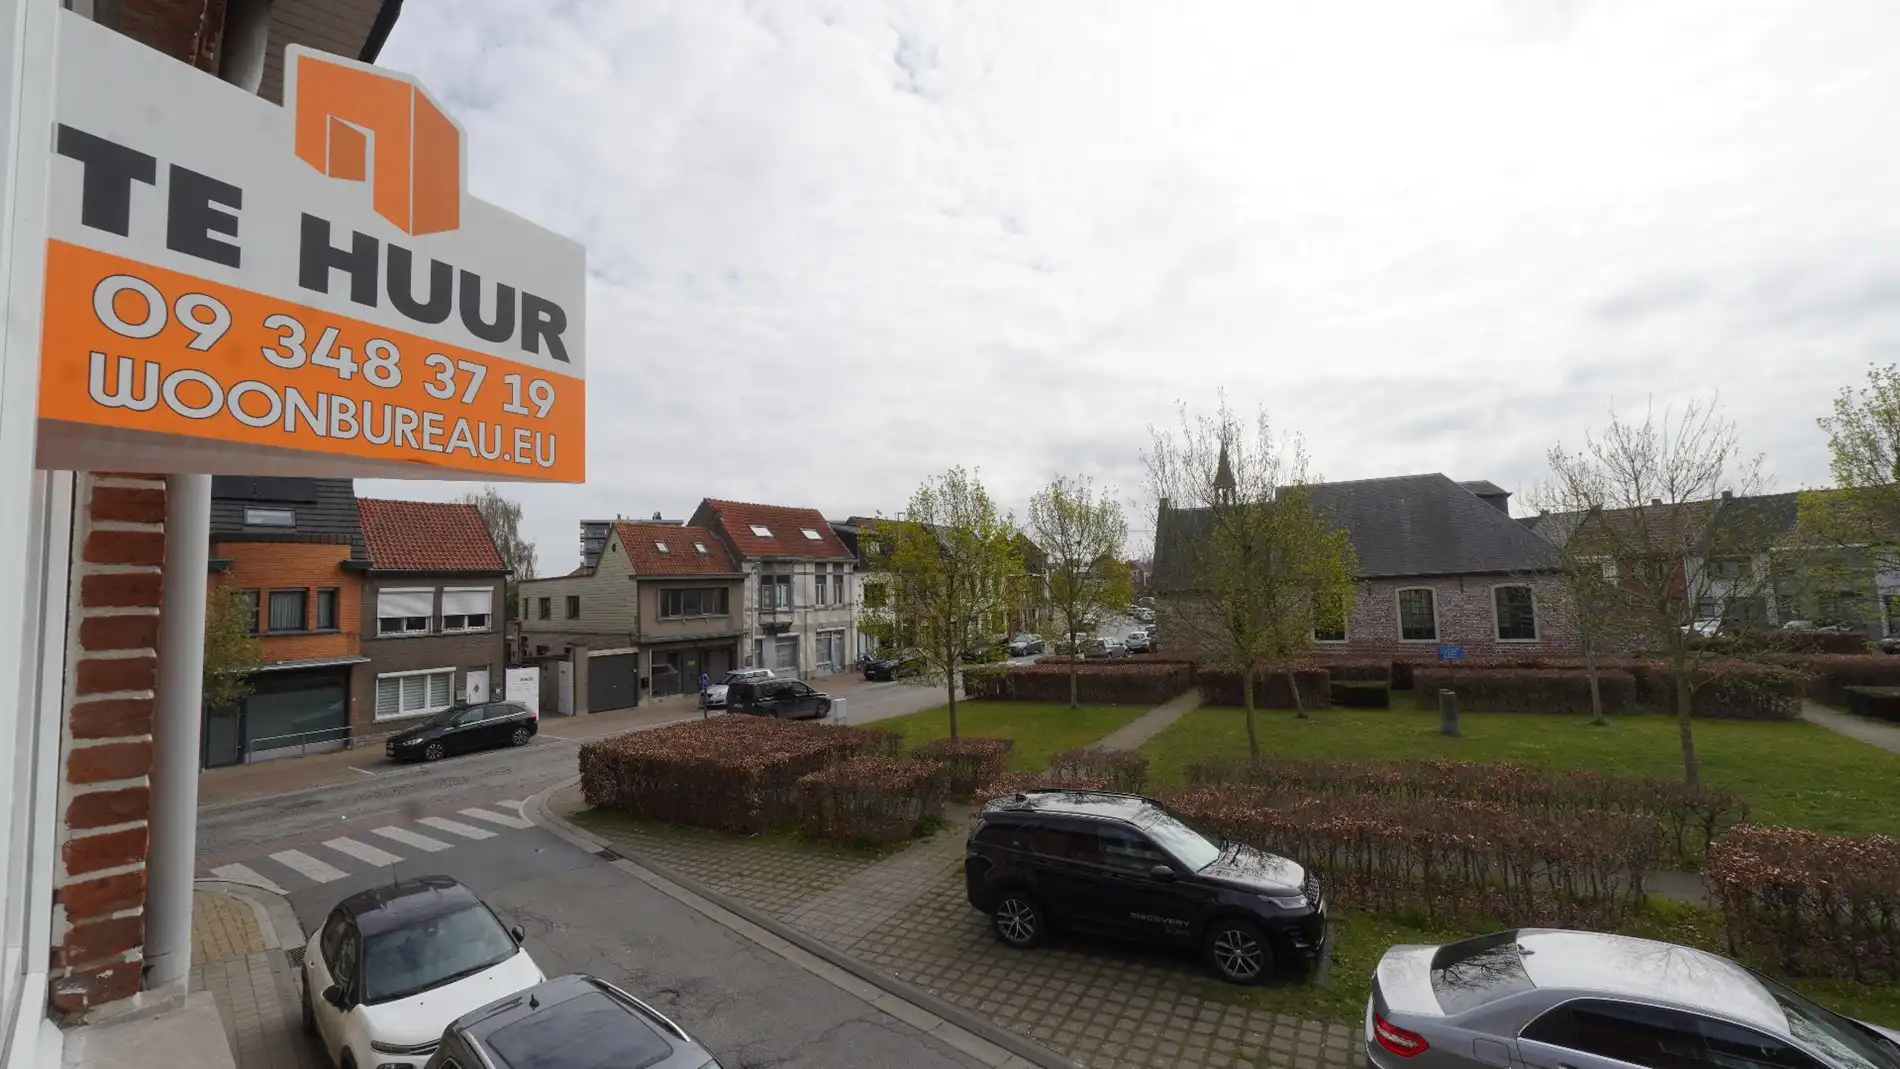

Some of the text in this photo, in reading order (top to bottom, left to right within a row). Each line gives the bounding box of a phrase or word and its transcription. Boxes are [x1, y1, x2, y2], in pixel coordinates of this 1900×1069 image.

[57, 122, 571, 363] TE HUUR
[88, 350, 556, 468] WOONBUREAU.EU
[92, 273, 556, 419] 09 348 37 19
